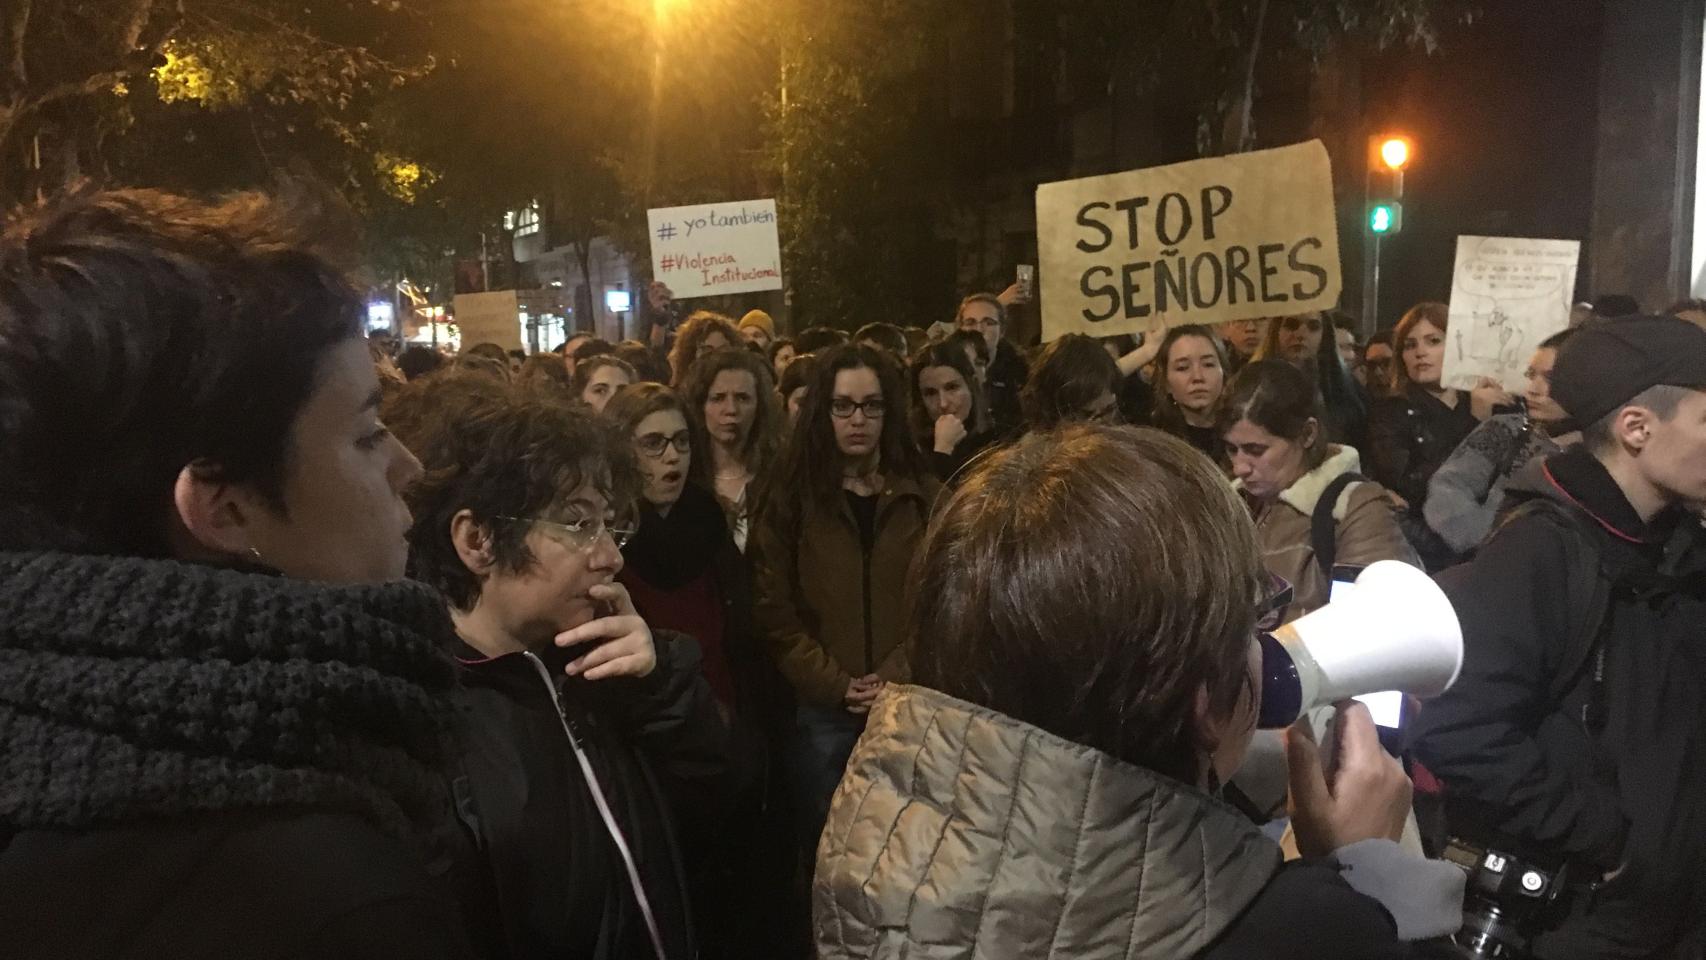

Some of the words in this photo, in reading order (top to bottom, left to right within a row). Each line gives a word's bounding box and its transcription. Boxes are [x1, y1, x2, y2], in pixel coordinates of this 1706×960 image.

[1075, 184, 1233, 253] STOP
[701, 260, 780, 287] Institucional
[1079, 236, 1328, 323] SEÑORES
